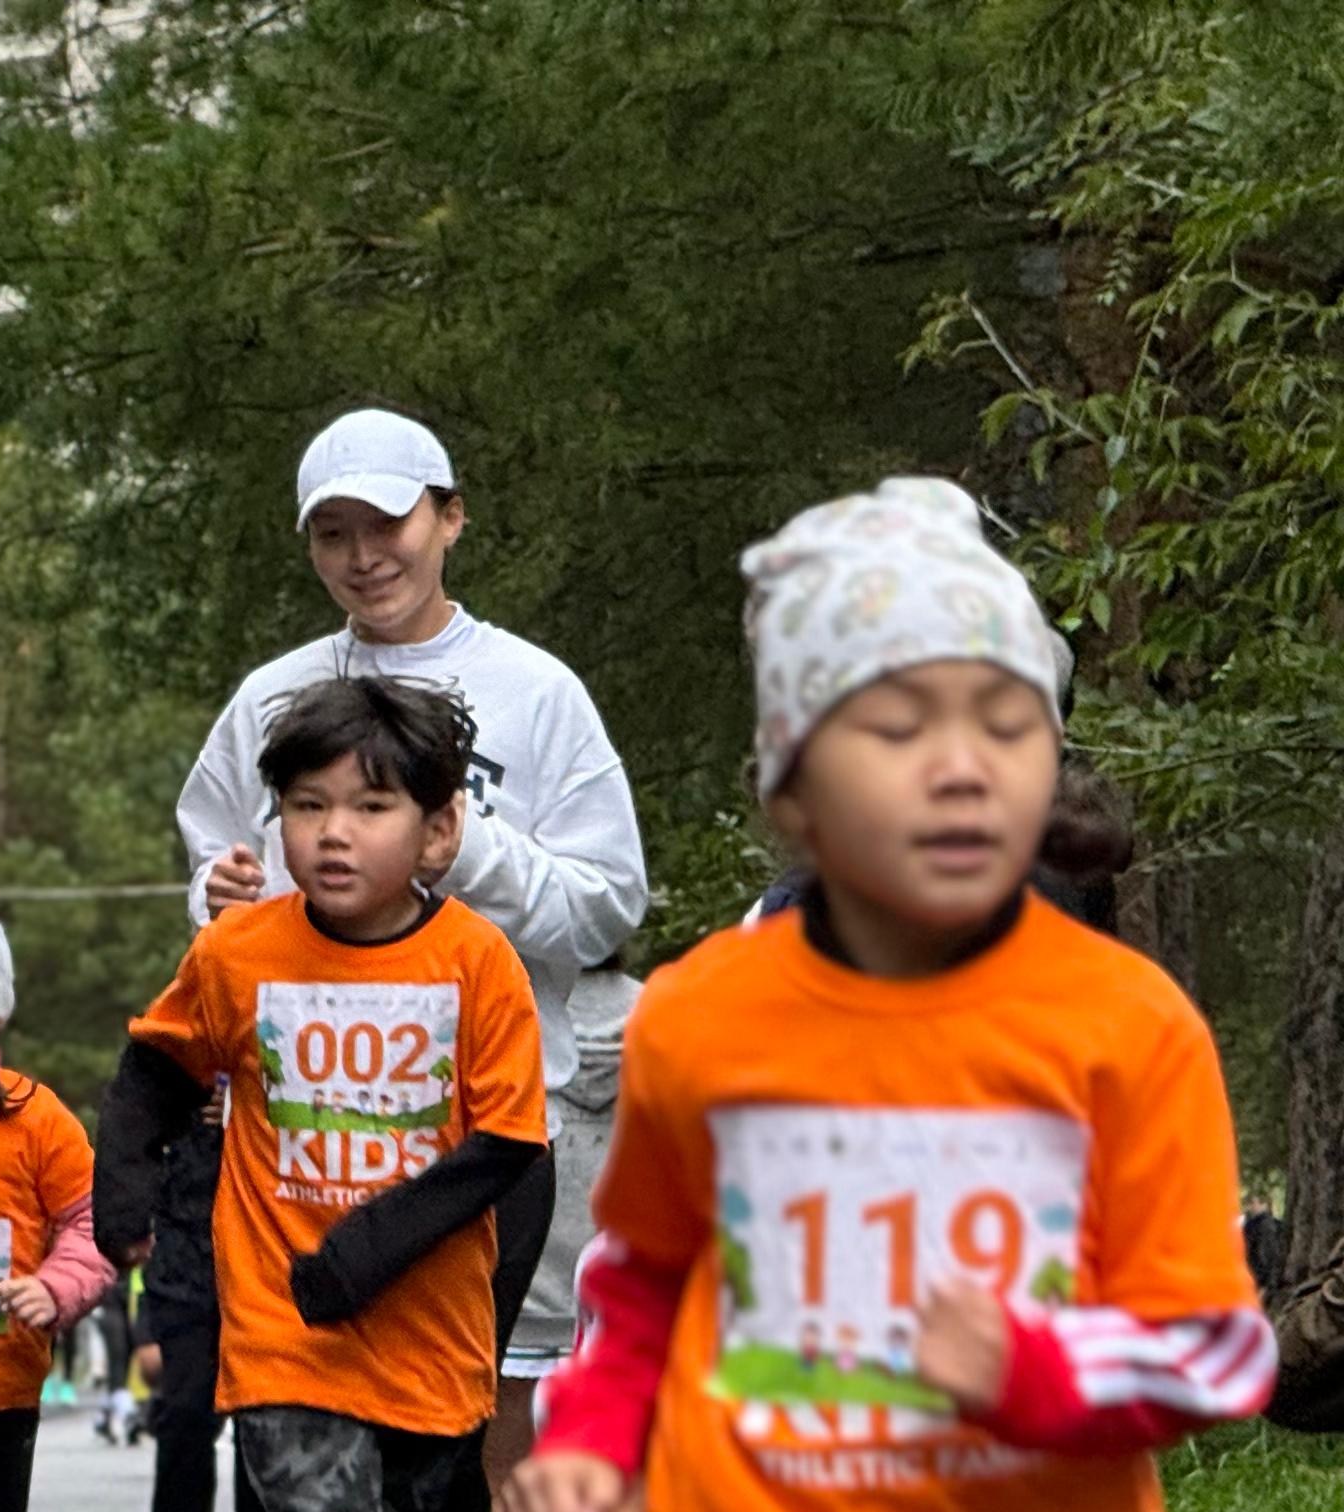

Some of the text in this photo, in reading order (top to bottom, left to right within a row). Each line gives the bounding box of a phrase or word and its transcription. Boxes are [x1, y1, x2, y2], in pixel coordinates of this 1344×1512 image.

[296, 1020, 431, 1084] 002
[278, 1127, 437, 1180] KIDS
[781, 1190, 1025, 1308] 119
